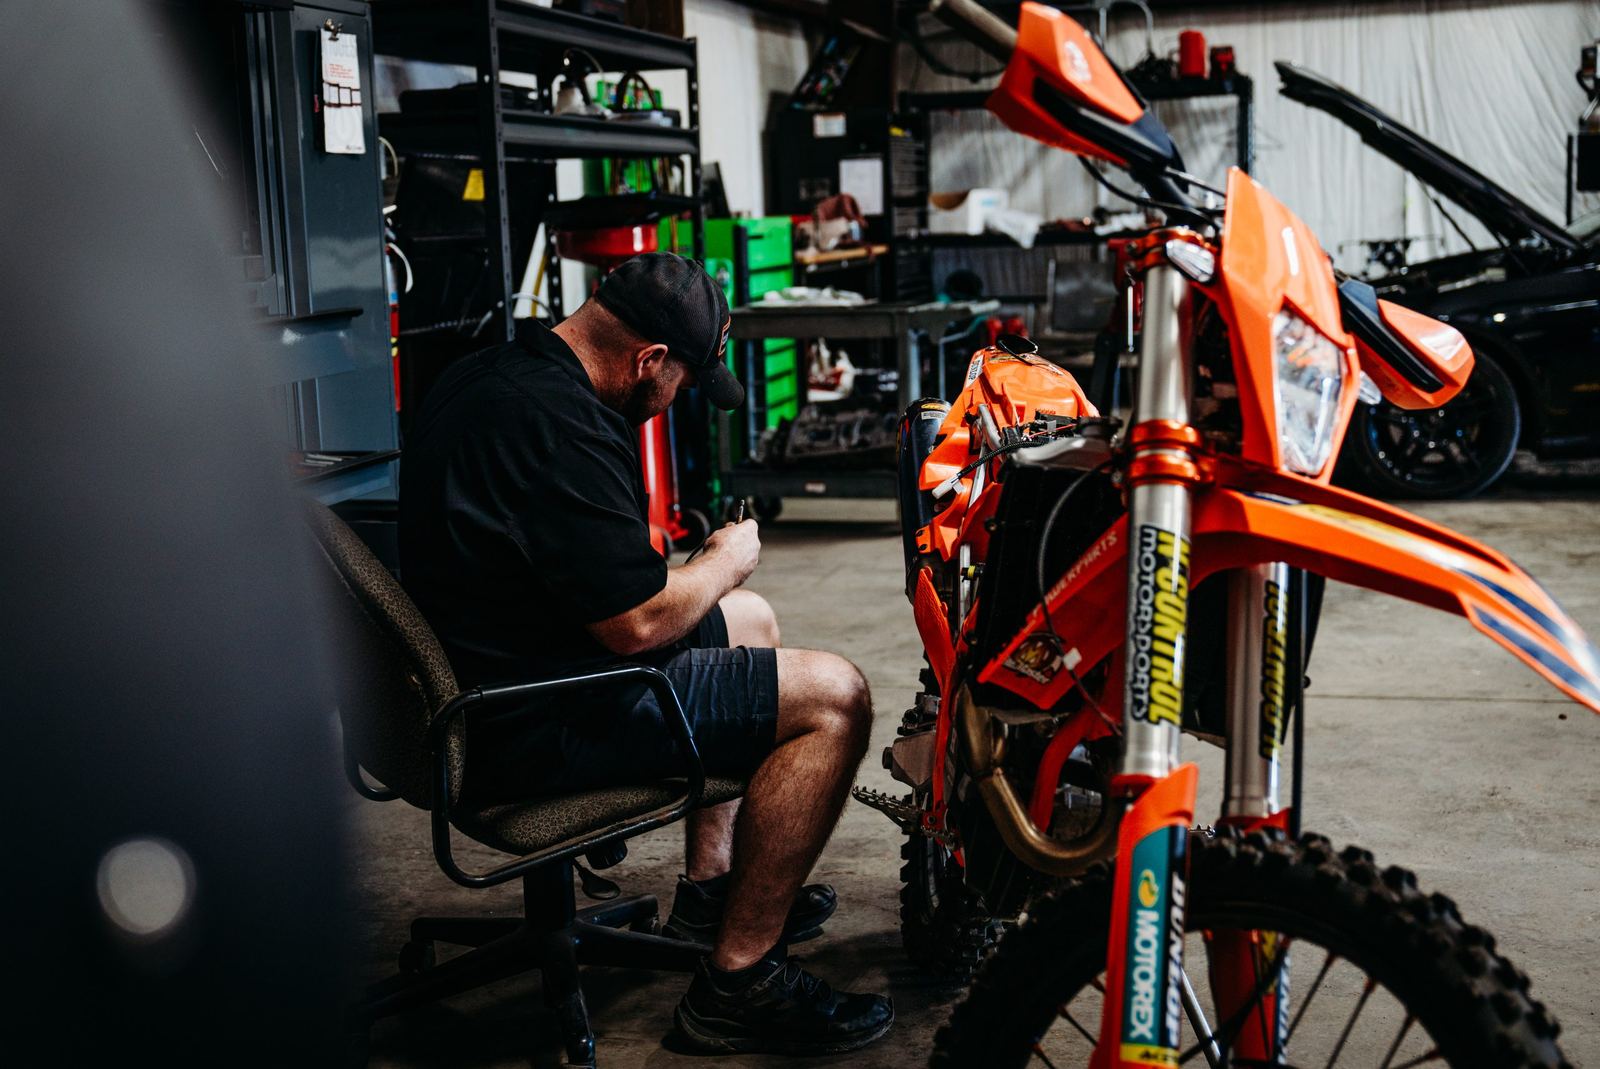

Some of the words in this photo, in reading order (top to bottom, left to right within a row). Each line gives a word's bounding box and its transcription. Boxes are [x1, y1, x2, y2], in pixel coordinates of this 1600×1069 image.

[1132, 527, 1157, 719] MOTORSPORTS
[1129, 909, 1160, 1040] MOTOREX
[1165, 871, 1186, 1047] DUNLOP
